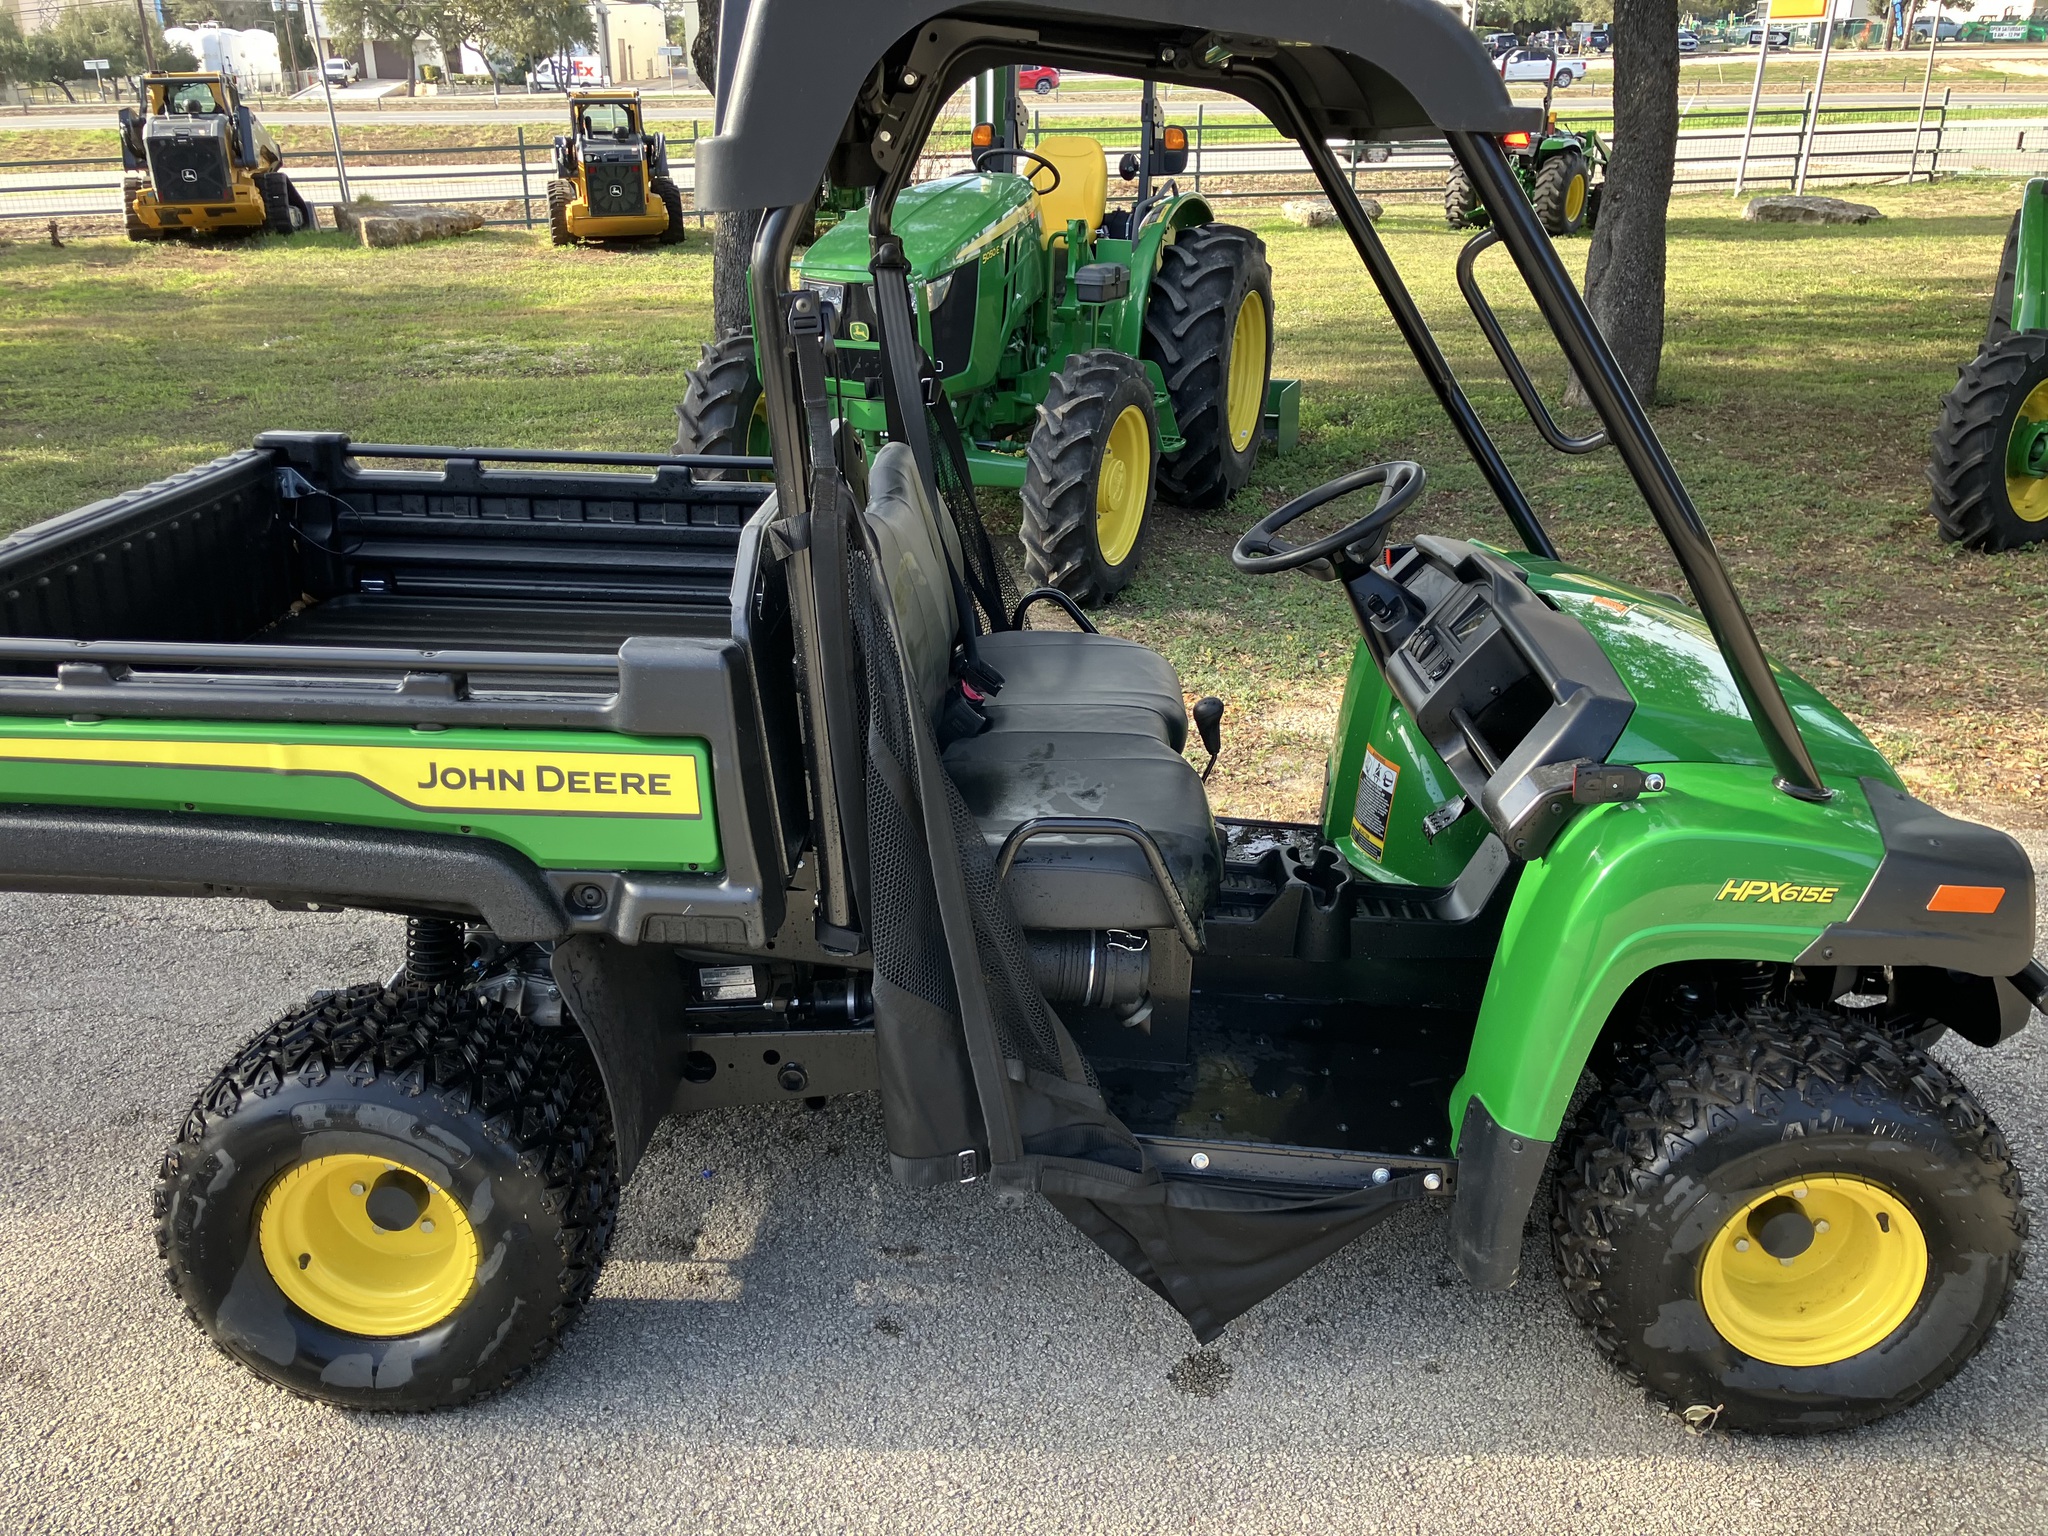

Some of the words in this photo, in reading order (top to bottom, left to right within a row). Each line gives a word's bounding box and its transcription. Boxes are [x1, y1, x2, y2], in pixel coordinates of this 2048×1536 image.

[418, 762, 525, 792] JOHN
[536, 765, 672, 796] DEERE
[1716, 879, 1839, 904] HPX615E
